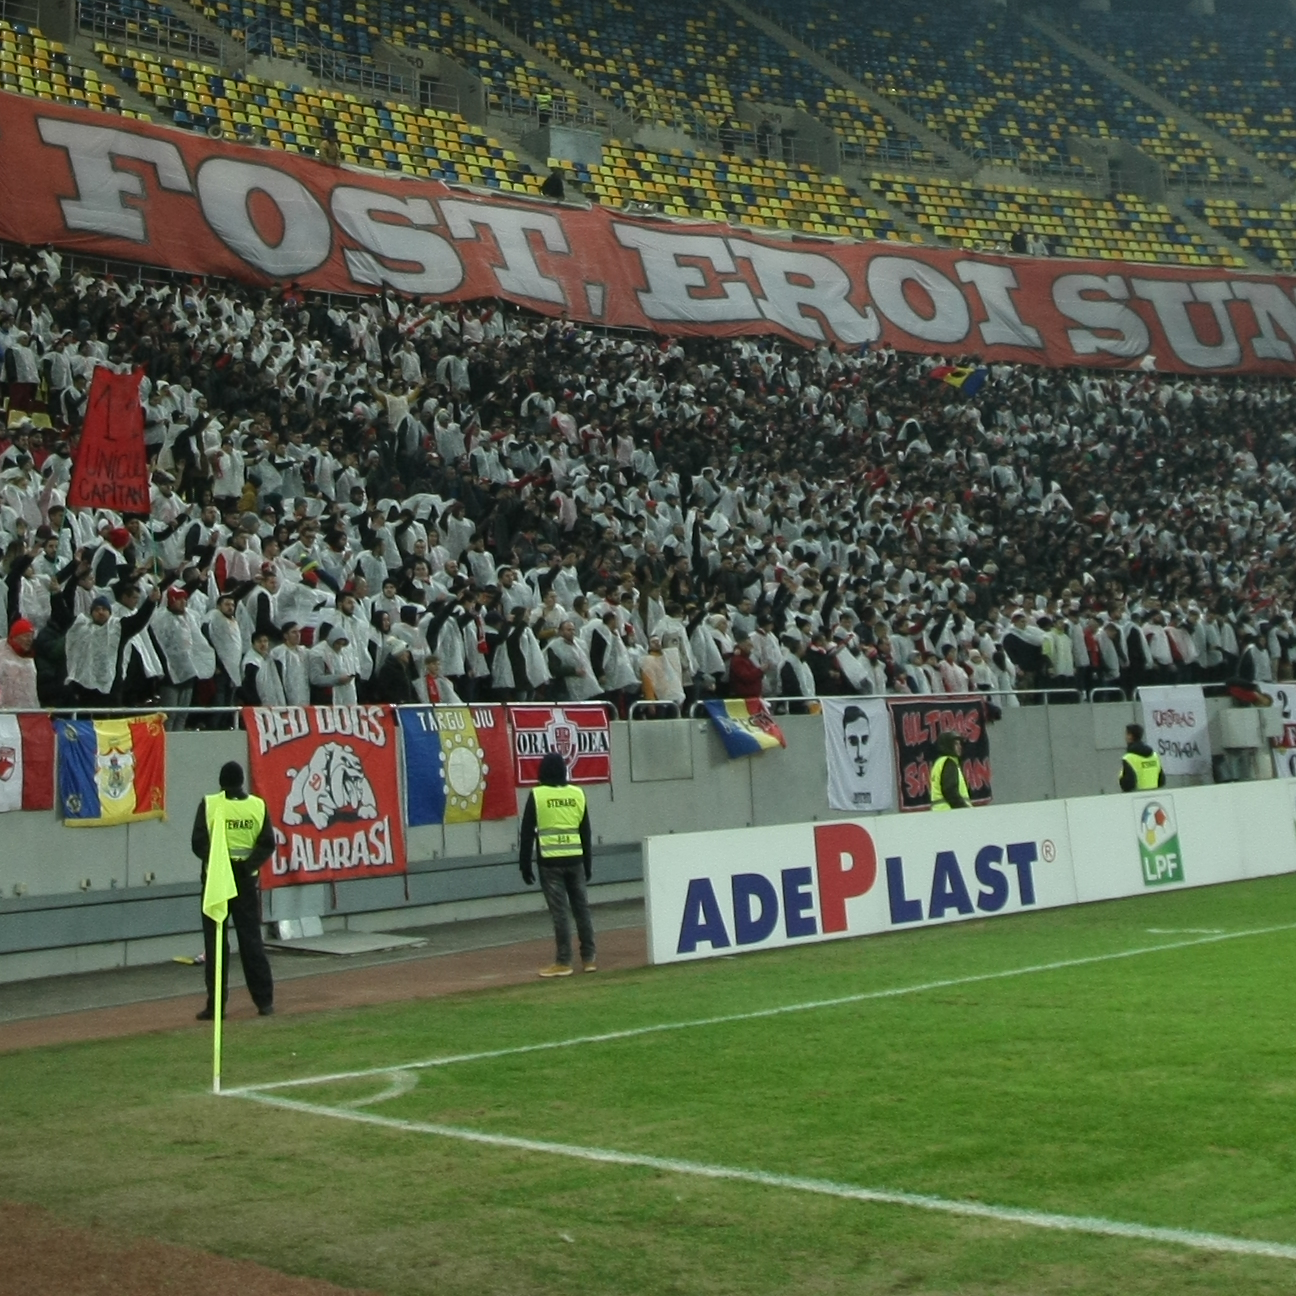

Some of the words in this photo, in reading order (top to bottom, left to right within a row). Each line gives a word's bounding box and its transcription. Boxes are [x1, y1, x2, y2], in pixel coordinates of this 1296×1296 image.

[612, 219, 1046, 349] EROI
[254, 705, 310, 755] RED
[314, 705, 386, 747] DOGS
[416, 710, 465, 732] TARGU
[271, 814, 394, 876] CALARASI
[1144, 853, 1179, 881] LPF
[676, 822, 1038, 955] ADEPLAST
